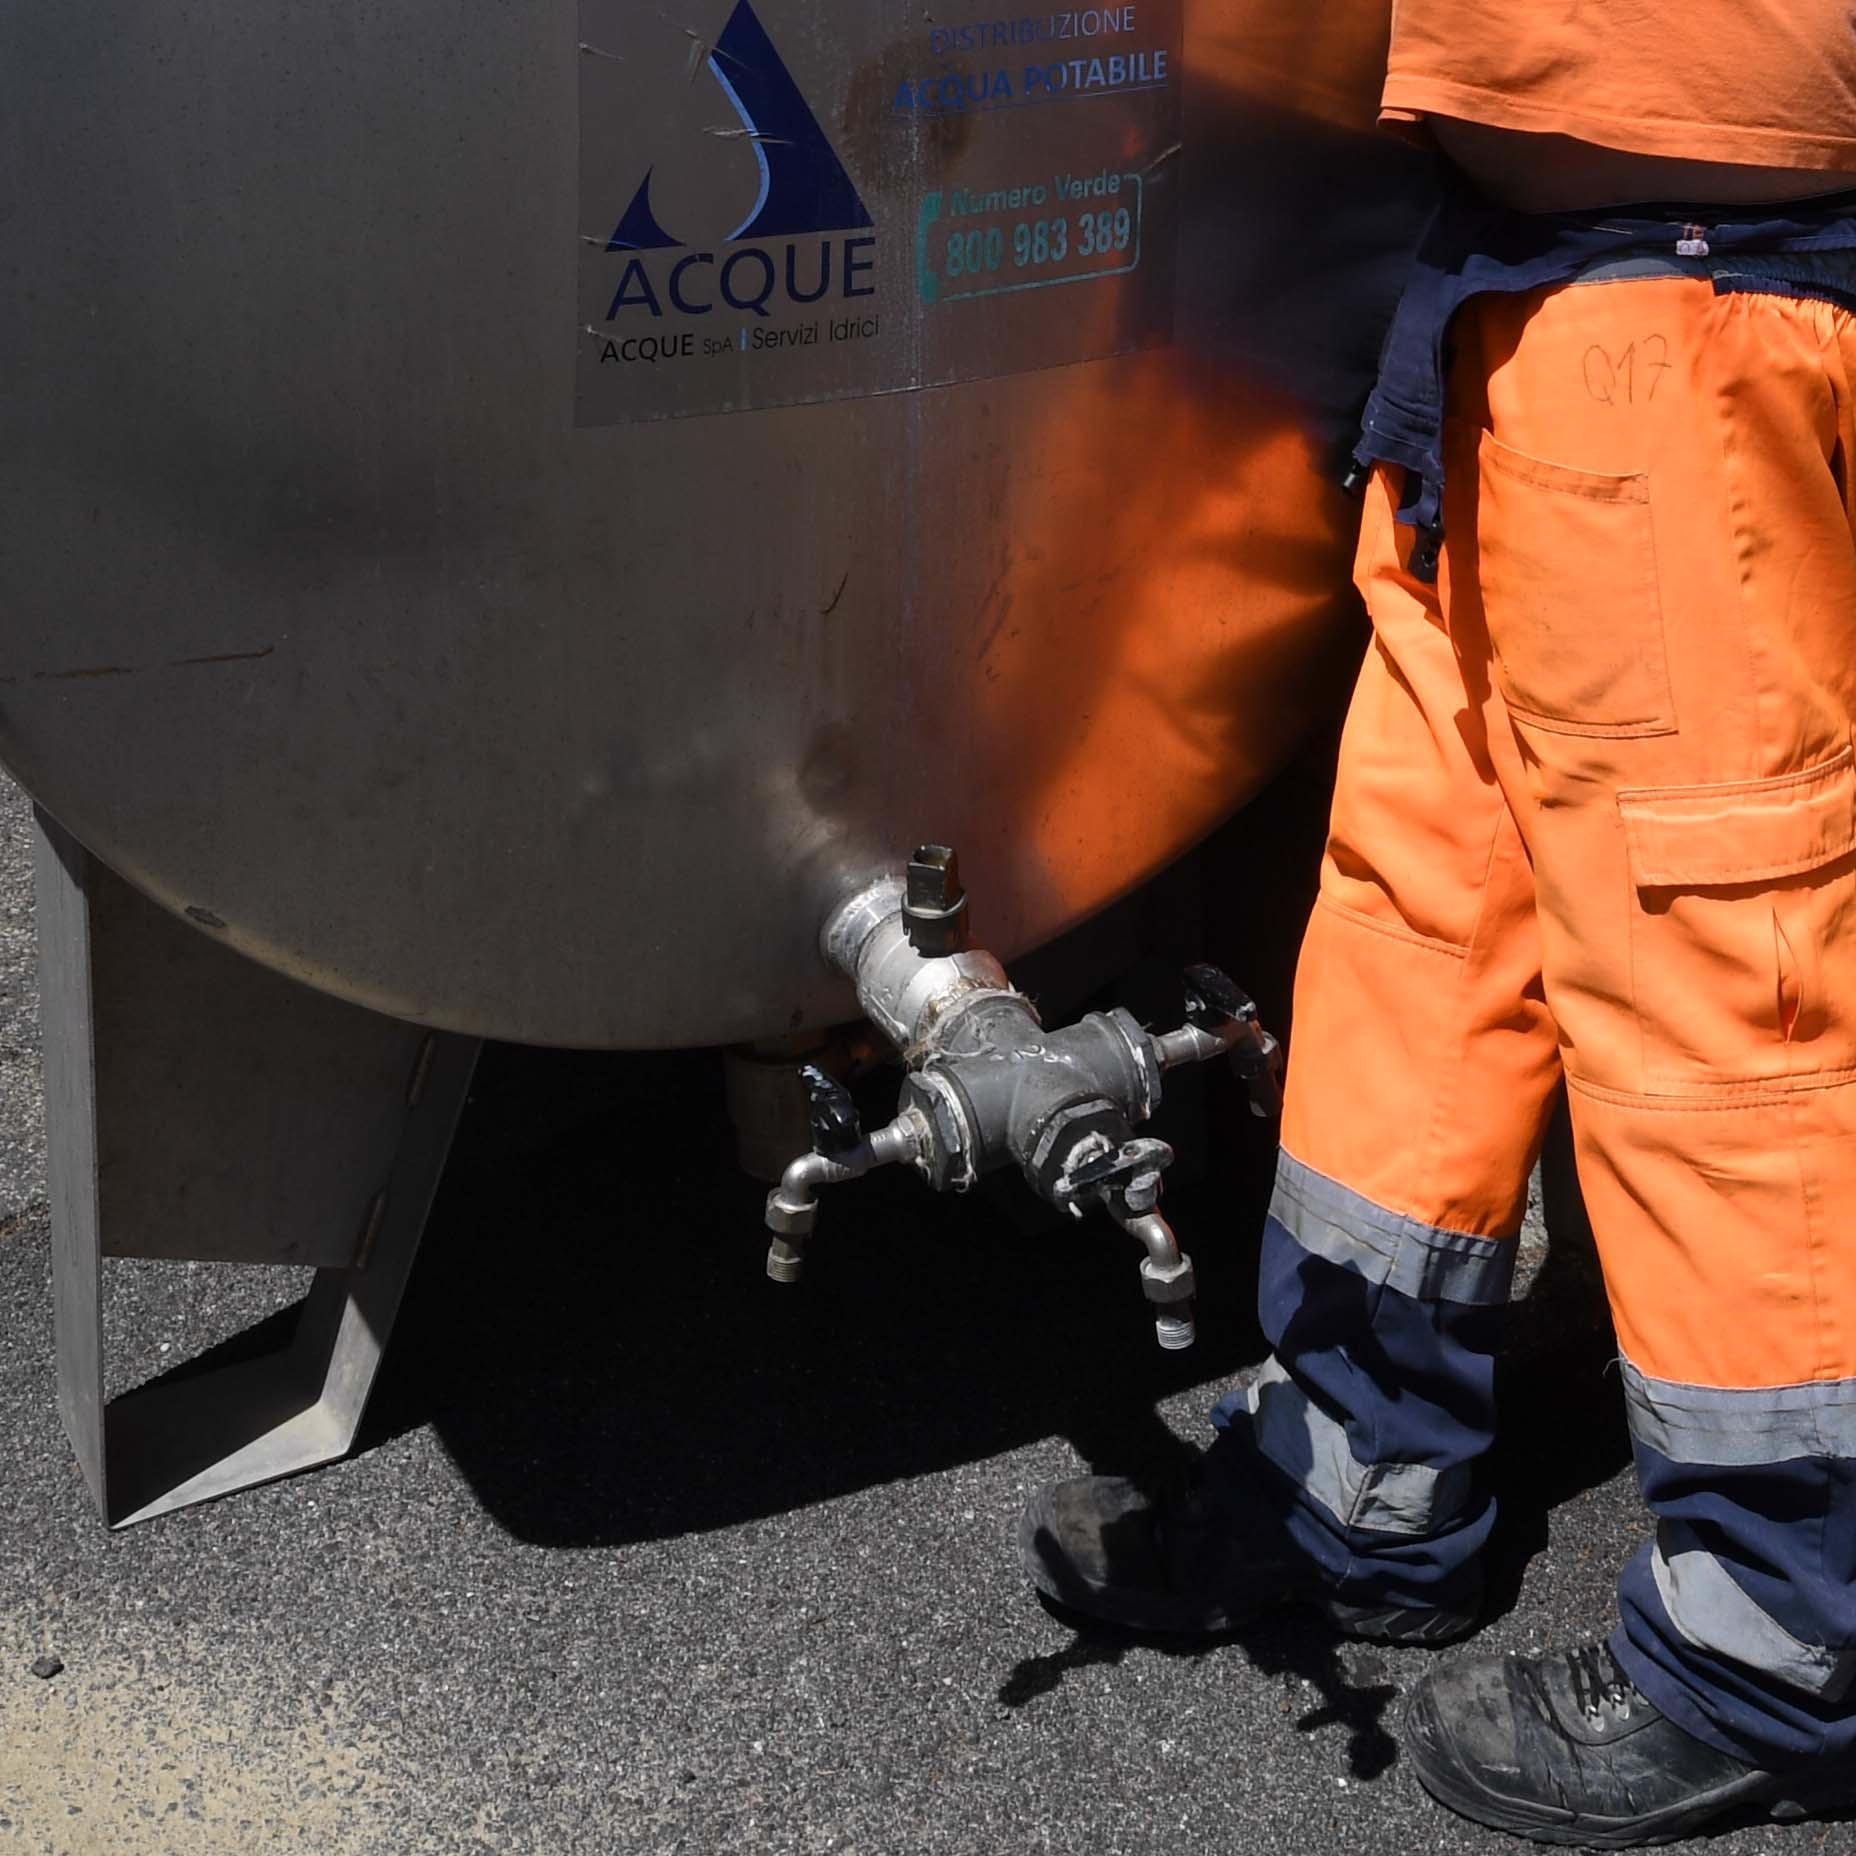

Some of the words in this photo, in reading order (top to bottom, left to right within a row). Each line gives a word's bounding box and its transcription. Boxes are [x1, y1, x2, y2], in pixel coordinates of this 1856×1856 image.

[930, 5, 1137, 55] DISTRIBUZIONE
[893, 69, 1014, 112] ACQUA
[1024, 49, 1169, 94] POTABILE
[950, 183, 1048, 217] Numero
[1054, 168, 1121, 201] Verde
[946, 227, 1005, 277] 800
[1013, 217, 1068, 267] 983
[1078, 207, 1131, 257] 389
[604, 236, 876, 321] ACQUE
[600, 333, 695, 364] ACQUE
[703, 336, 735, 358] SpA
[752, 320, 820, 350] Servizi
[828, 315, 880, 342] Idrici
